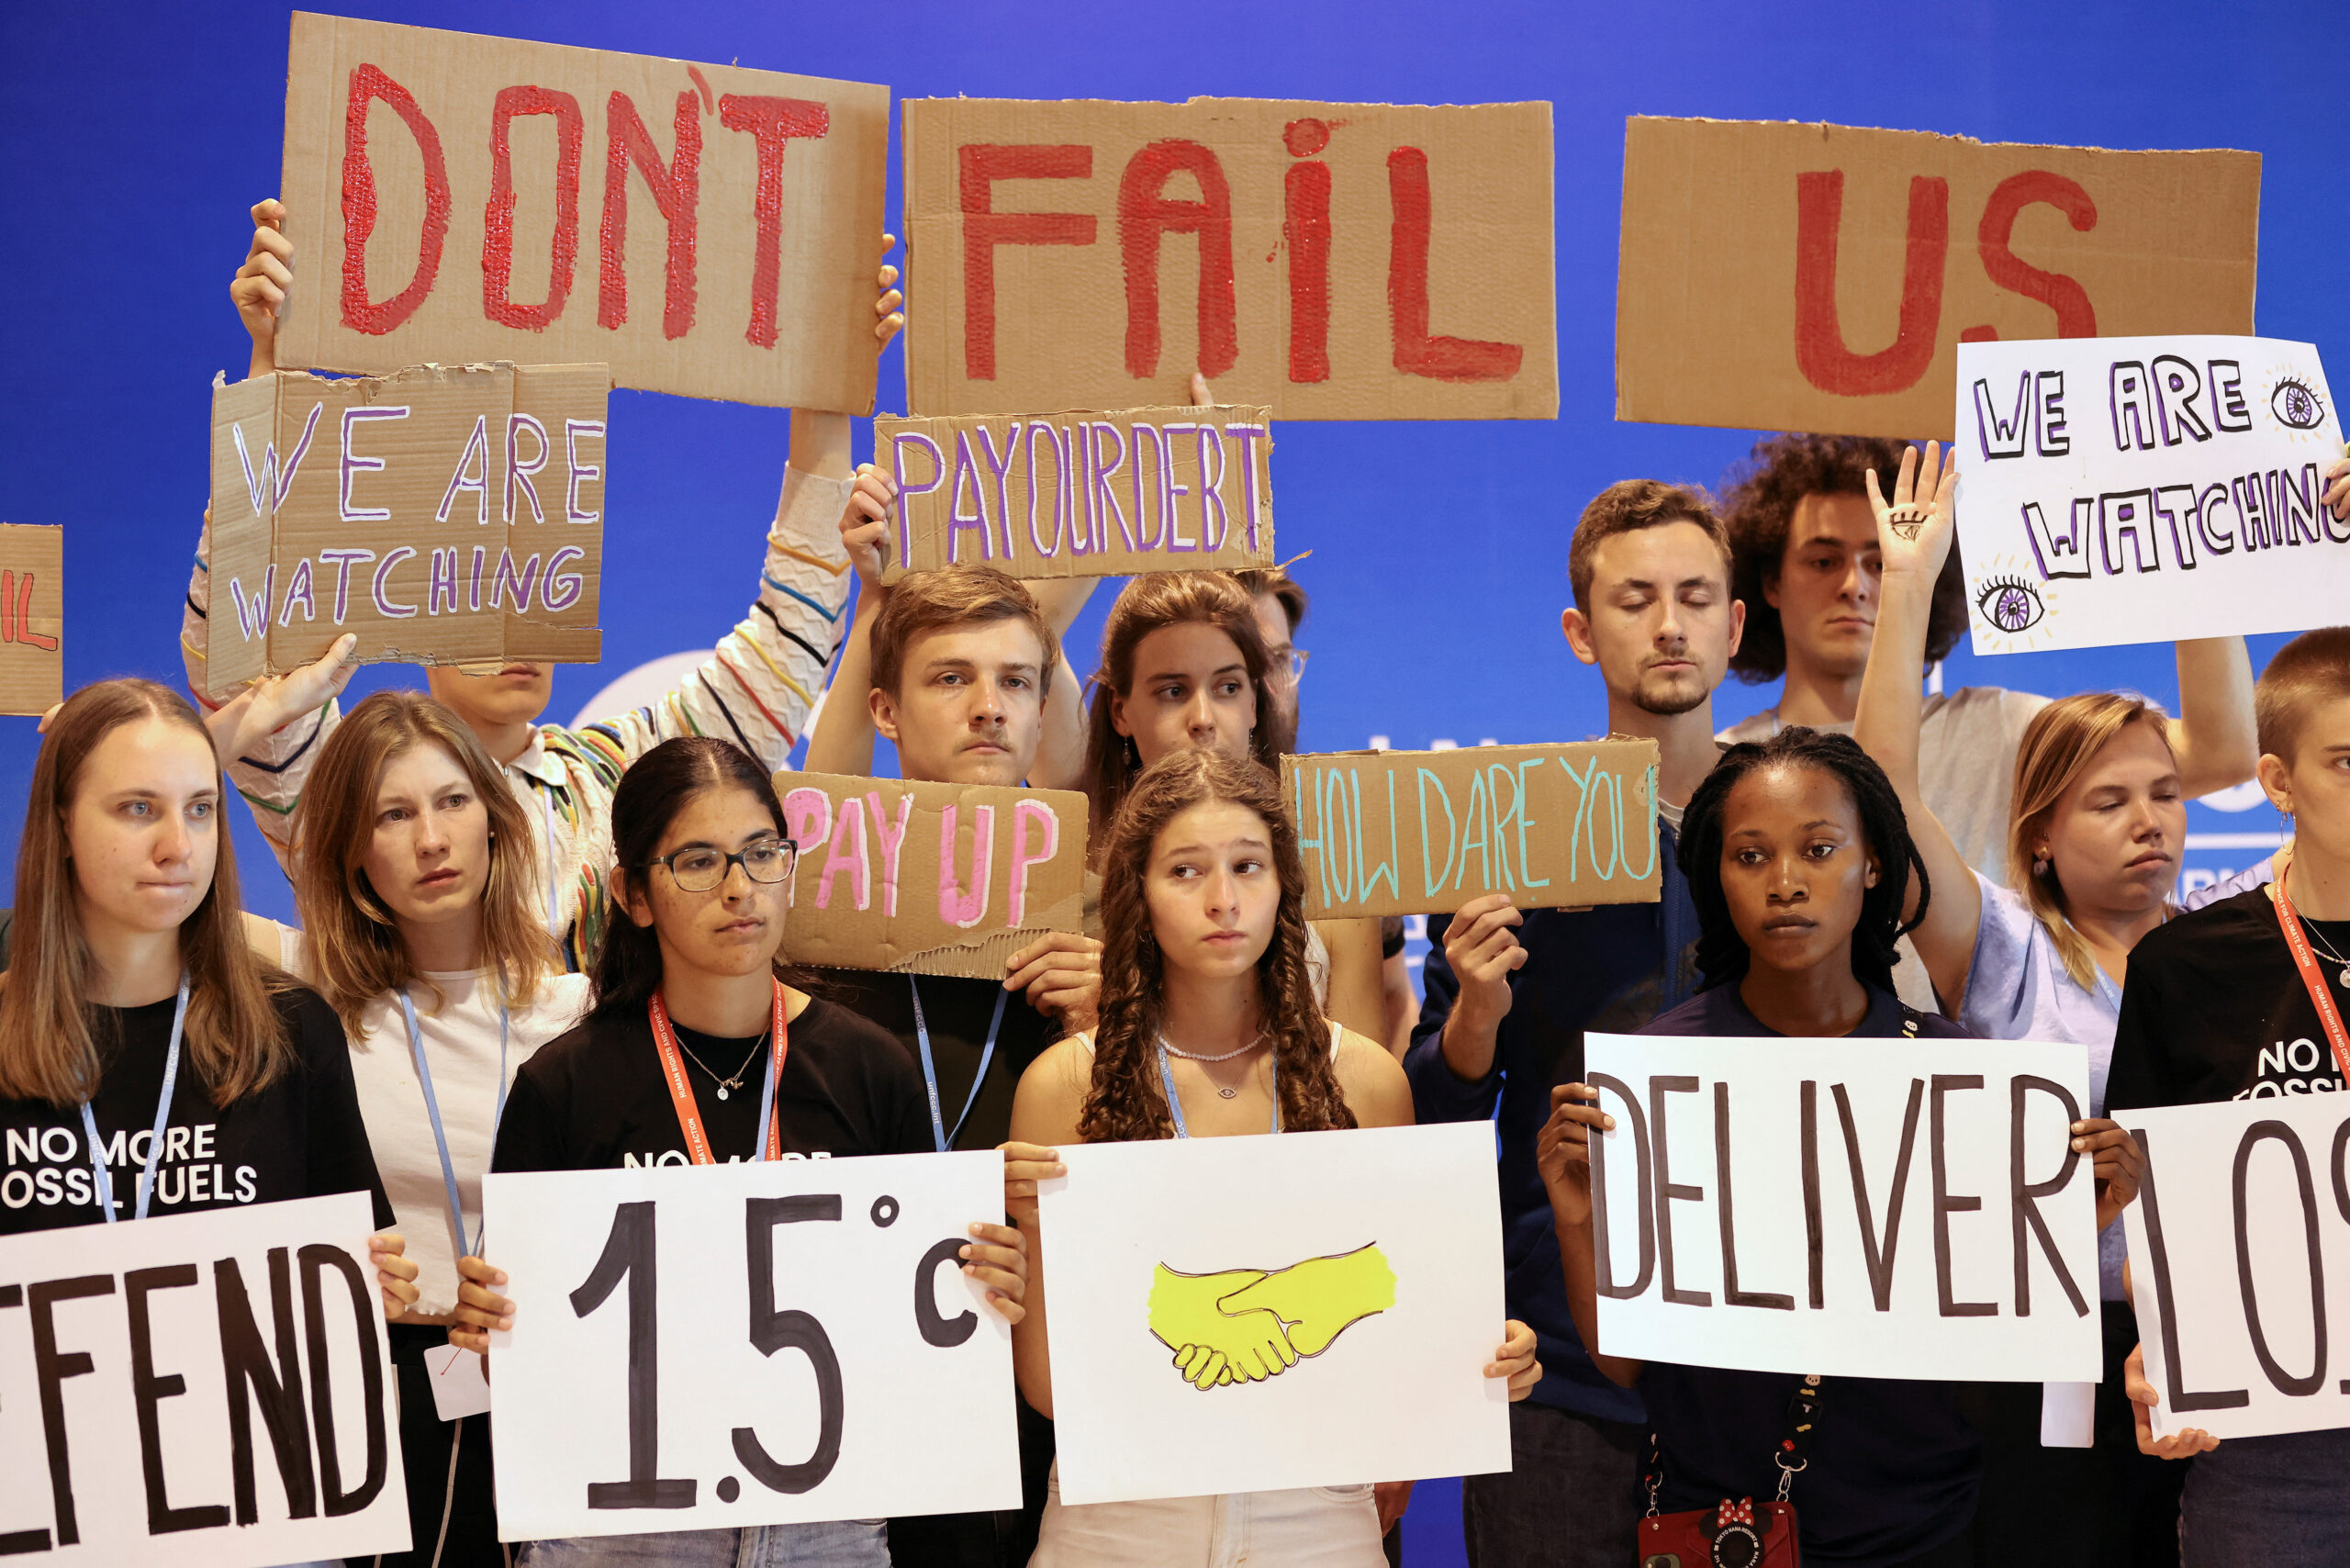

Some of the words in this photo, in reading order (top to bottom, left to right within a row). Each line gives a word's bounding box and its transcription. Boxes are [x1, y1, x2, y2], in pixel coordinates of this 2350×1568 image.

[340, 62, 830, 350] DON'T
[1795, 169, 2098, 398] US
[1973, 370, 2071, 461] WE
[2109, 354, 2253, 453] ARE
[232, 401, 410, 522] WE
[435, 413, 607, 526] ARE
[229, 545, 586, 644] WATCHING
[783, 787, 915, 918] PAY
[938, 798, 1059, 929] UP
[1294, 767, 1399, 910] HOW
[1416, 757, 1550, 899] DARE
[1558, 756, 1657, 882] YOU
[2285, 913, 2301, 946] CLIMATE
[2297, 941, 2311, 968] ACTION
[655, 1012, 666, 1033] CIVIC
[660, 1030, 671, 1048] AND
[2314, 984, 2330, 1011] HUMAN
[2325, 1009, 2340, 1034] RIGHTS
[2334, 1030, 2346, 1050] AND
[164, 1046, 179, 1085] UNFCCC
[666, 1047, 680, 1072] RIGHTS
[673, 1070, 687, 1099] HUMAN
[2257, 1037, 2320, 1077] NO
[6, 1126, 78, 1167] NO
[89, 1124, 217, 1168] MORE
[687, 1117, 702, 1143] ACTION
[1587, 1070, 2090, 1319] DELIVER
